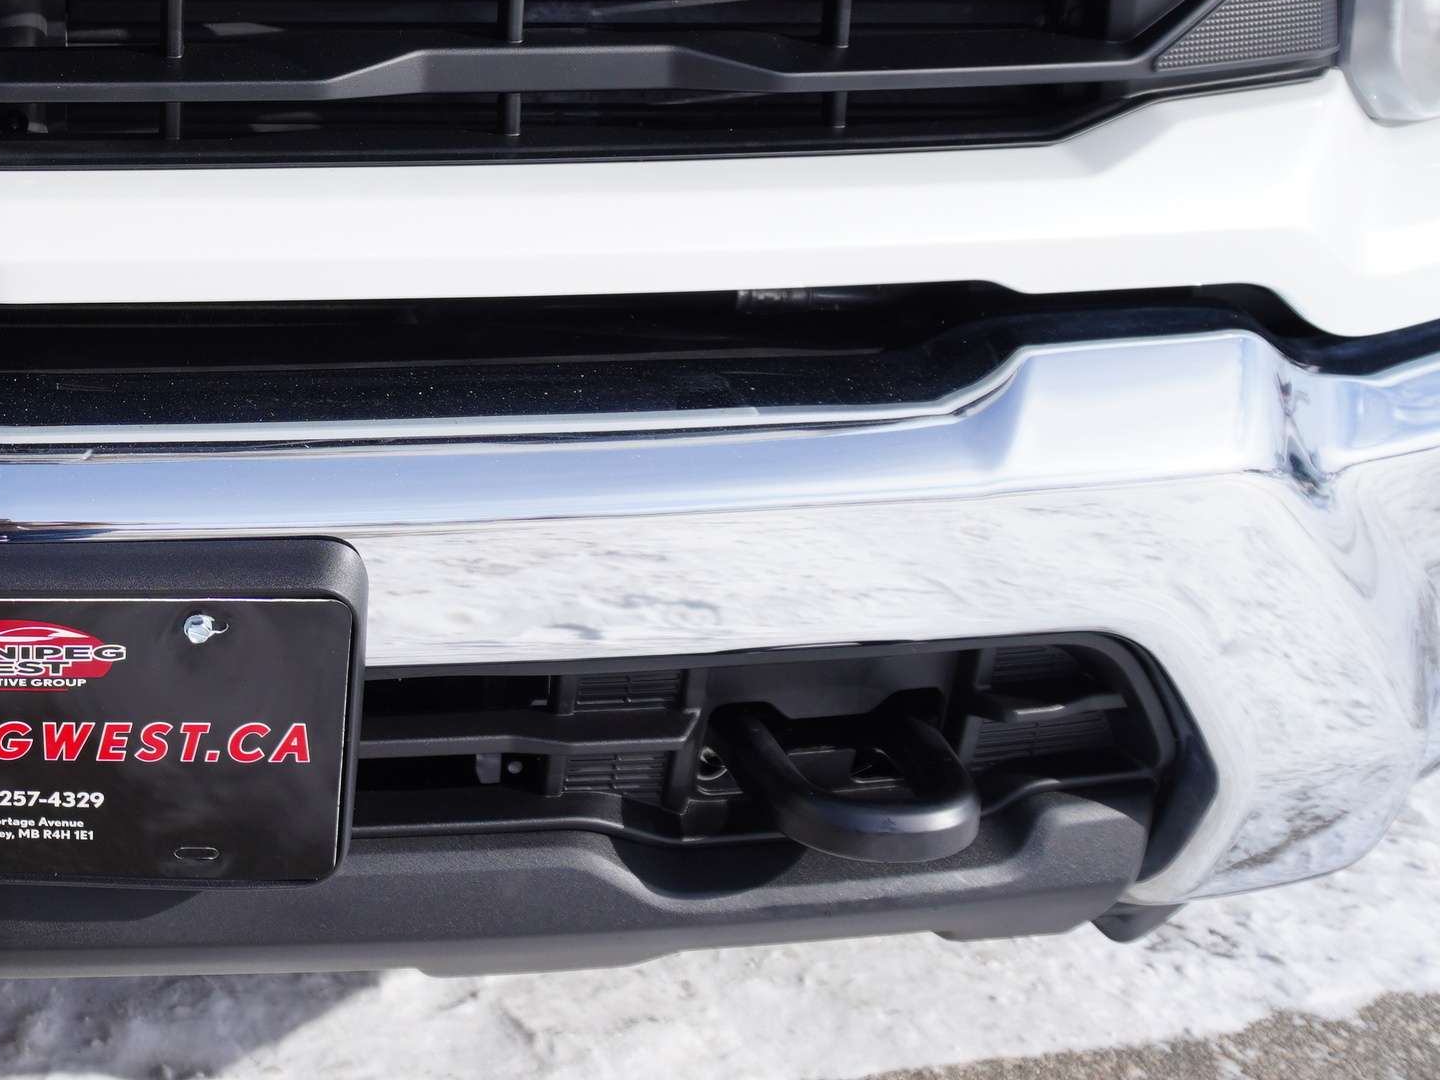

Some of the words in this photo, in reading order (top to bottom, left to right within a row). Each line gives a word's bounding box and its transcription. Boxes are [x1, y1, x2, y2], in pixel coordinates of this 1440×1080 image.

[30, 678, 87, 688] GROUP
[38, 817, 84, 828] Avenue
[18, 828, 40, 839] MB
[43, 829, 71, 840] R4H
[74, 830, 94, 840] 1E1
